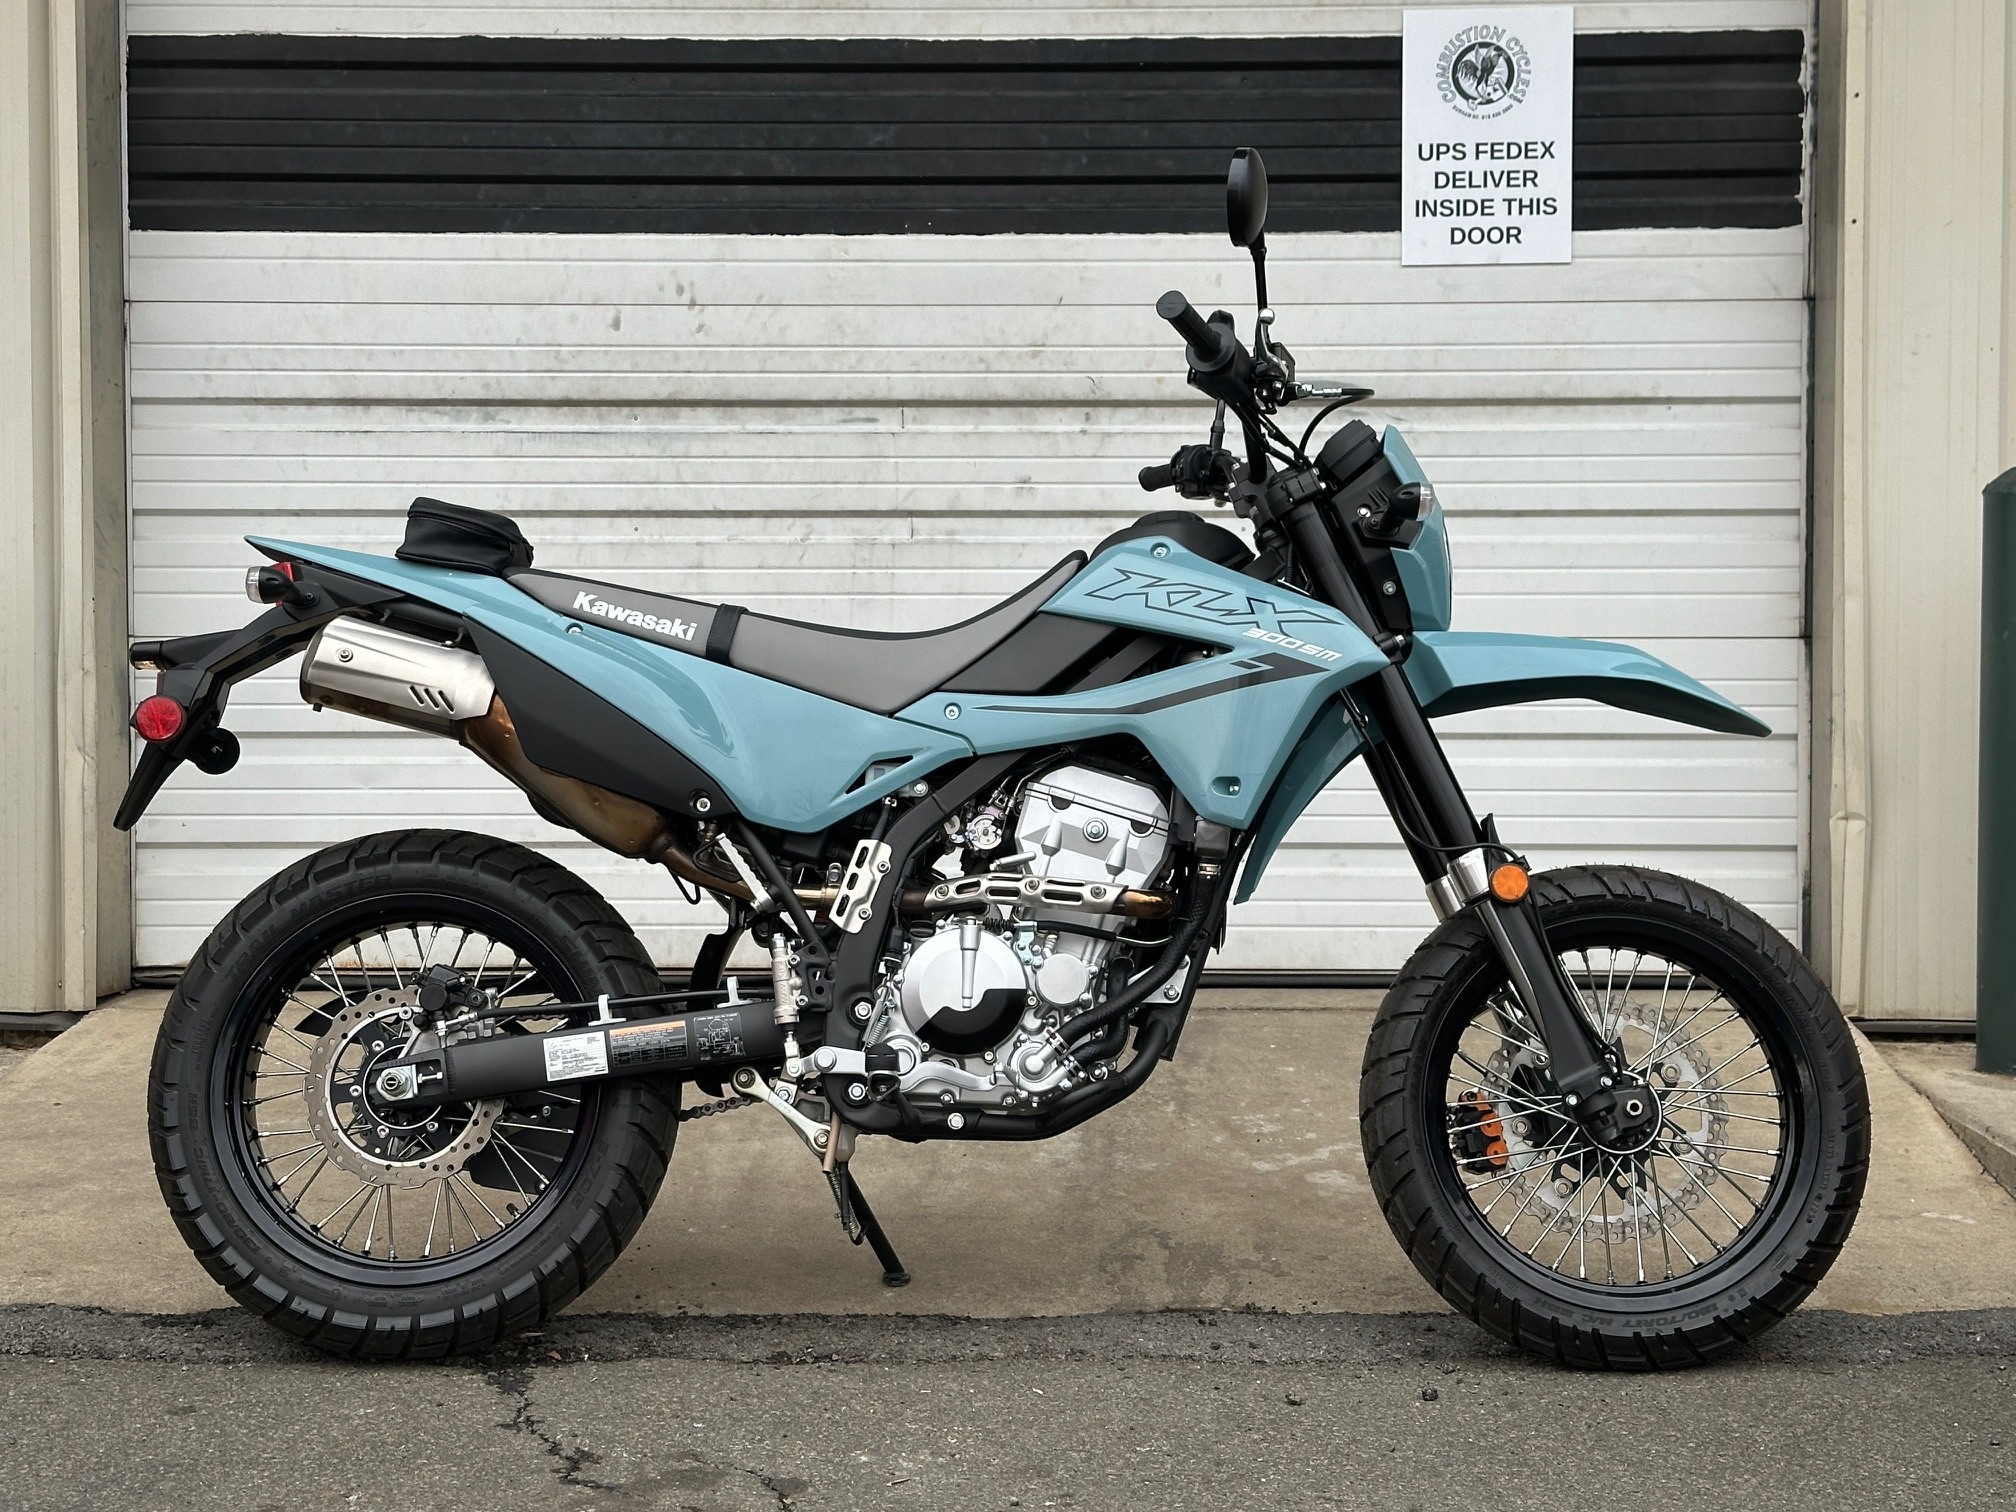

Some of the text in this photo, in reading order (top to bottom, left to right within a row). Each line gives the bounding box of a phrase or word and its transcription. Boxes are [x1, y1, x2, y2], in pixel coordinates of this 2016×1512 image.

[1436, 25, 1506, 103] COMBUSTION
[1506, 37, 1531, 97] CYCLES
[1418, 141, 1555, 161] UPS FEDEX
[1434, 170, 1539, 189] DELIVER
[1415, 198, 1557, 217] INSIDE THIS
[1450, 226, 1522, 245] DOOR
[572, 590, 698, 642] Kawasaki
[1083, 567, 1345, 638] KLX
[222, 874, 390, 986] TRAIL MASTER
